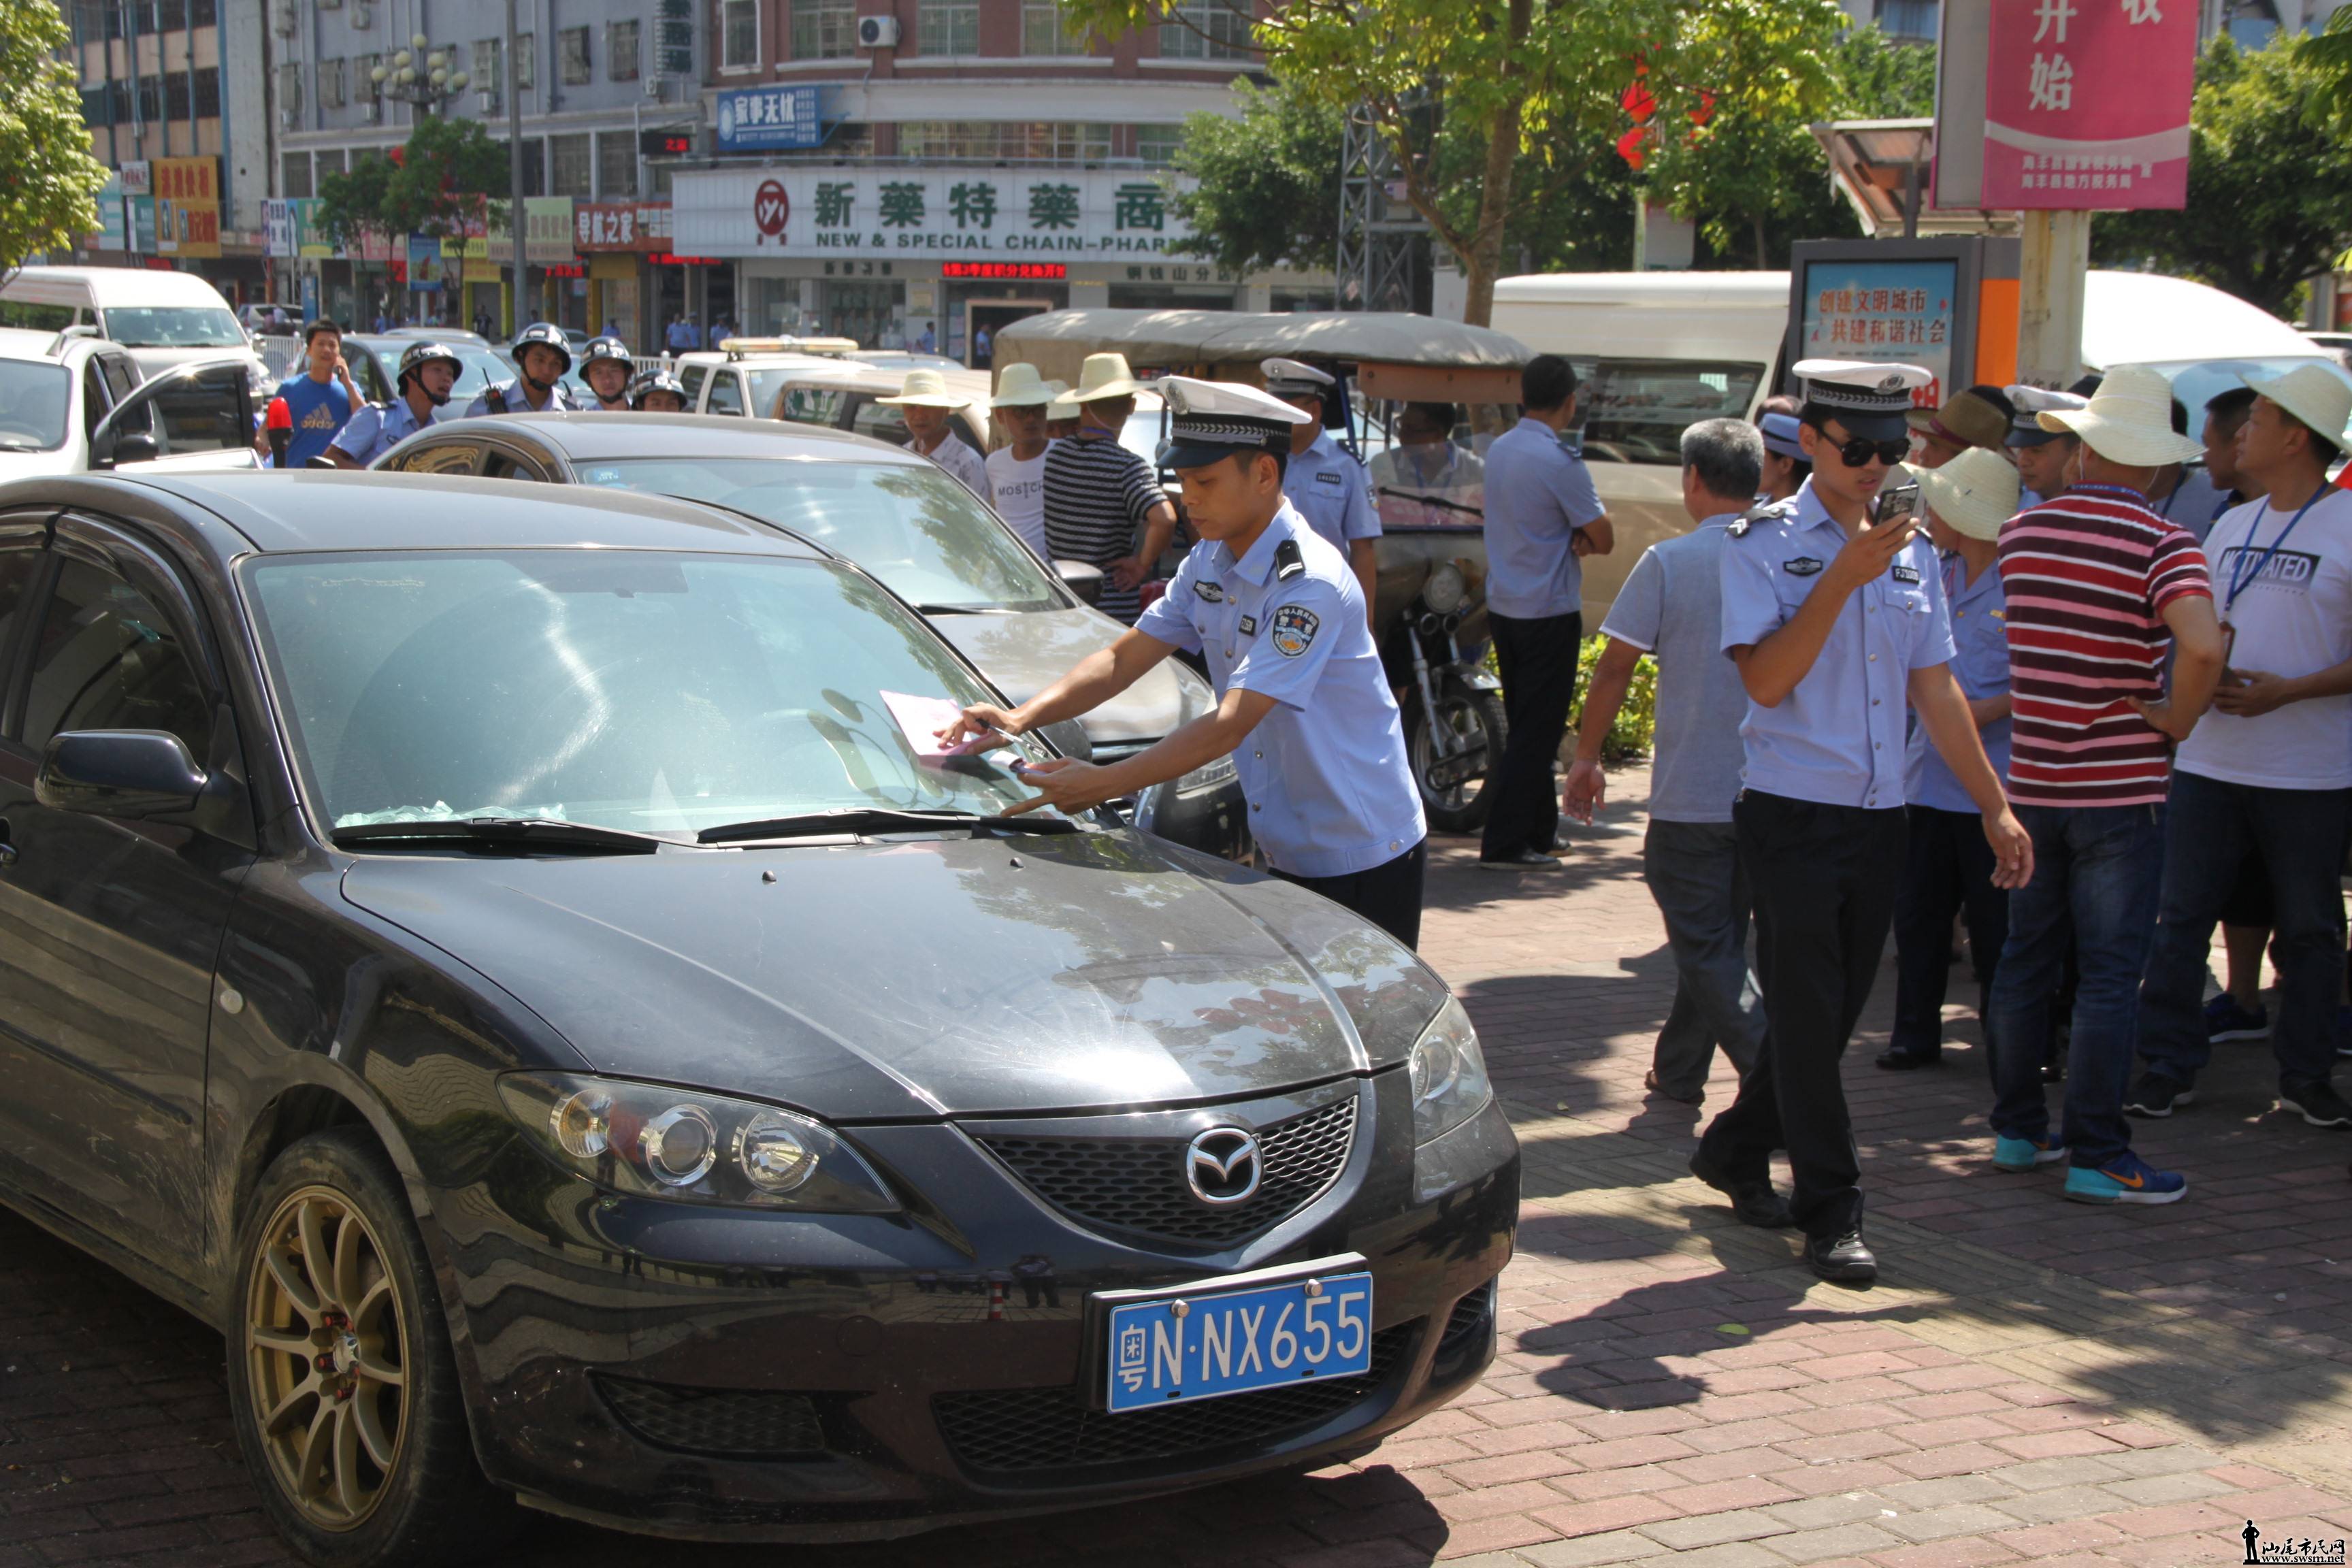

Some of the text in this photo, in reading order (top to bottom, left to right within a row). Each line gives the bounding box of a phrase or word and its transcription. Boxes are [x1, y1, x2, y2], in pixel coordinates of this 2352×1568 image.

[817, 233, 861, 247] NEW
[872, 233, 886, 248] &
[898, 233, 992, 250] SPECIAL
[1819, 289, 1927, 314] 创建文明城市
[1831, 319, 1946, 344] 共建和谐社会
